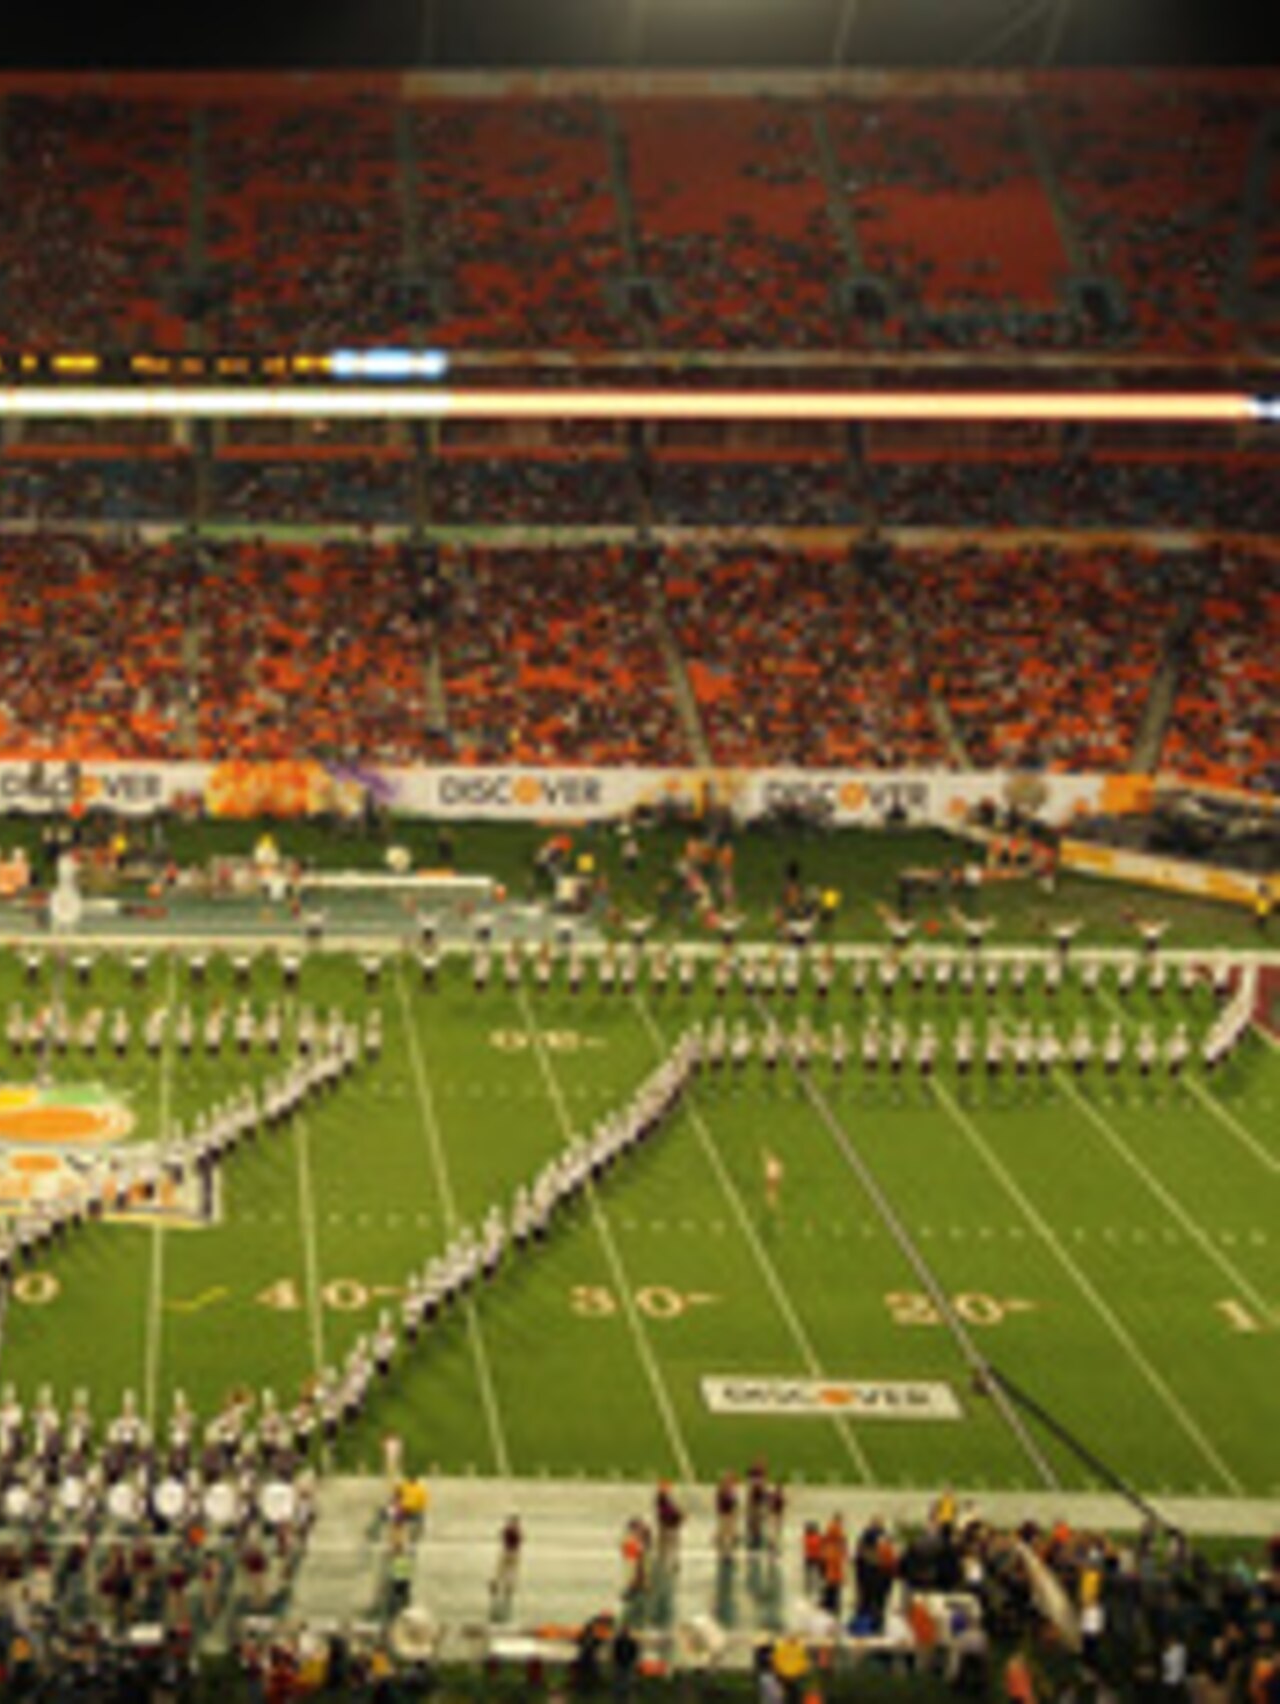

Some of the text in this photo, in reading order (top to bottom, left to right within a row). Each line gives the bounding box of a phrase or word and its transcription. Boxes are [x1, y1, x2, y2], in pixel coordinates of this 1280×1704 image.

[439, 774, 600, 805] DISCOVER
[255, 1279, 369, 1311] 40
[568, 1285, 685, 1318] 30
[884, 1291, 1005, 1325] 20
[722, 1385, 930, 1409] DISCOVER
